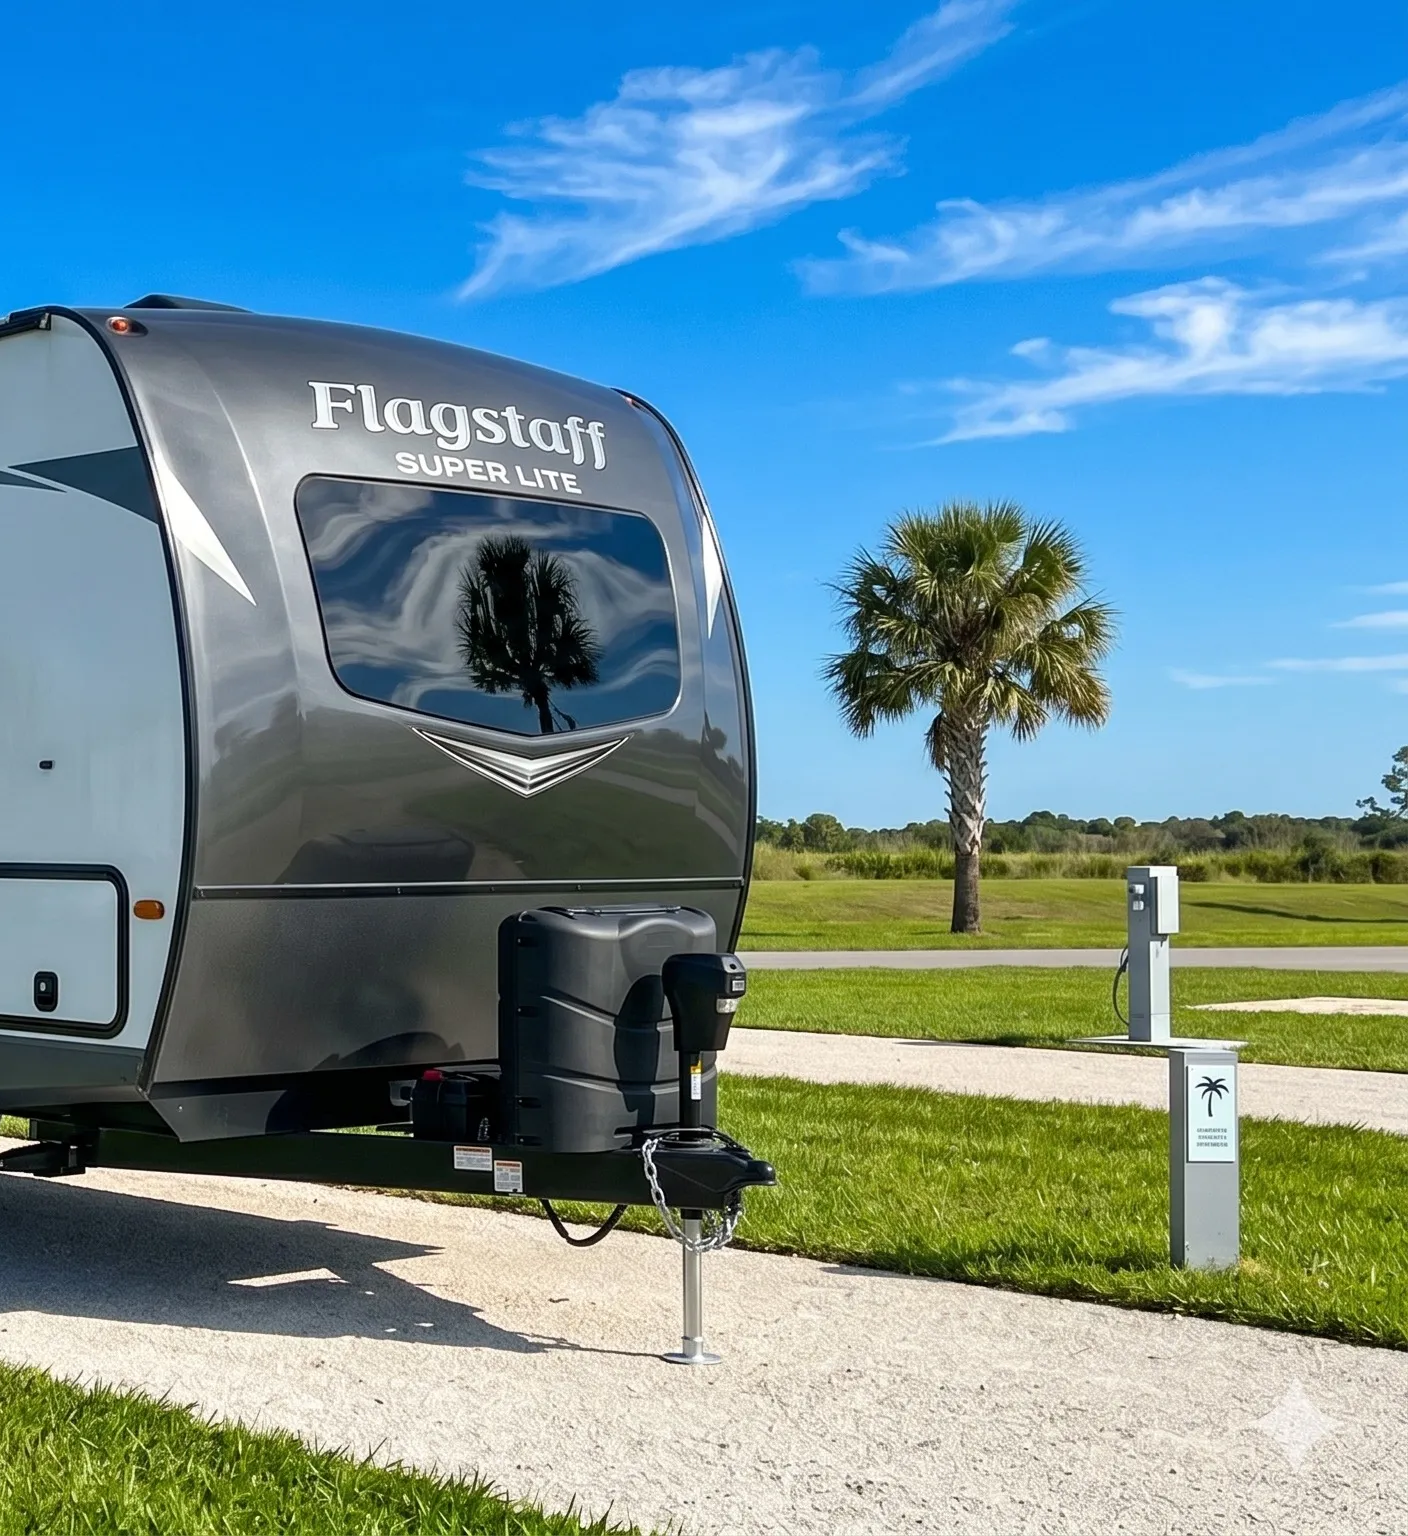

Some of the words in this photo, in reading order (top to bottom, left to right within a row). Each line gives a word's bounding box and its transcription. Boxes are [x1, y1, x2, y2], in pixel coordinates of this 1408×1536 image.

[308, 381, 607, 470] Flagstaff
[396, 452, 510, 484] SUPER
[515, 465, 583, 494] LITE
